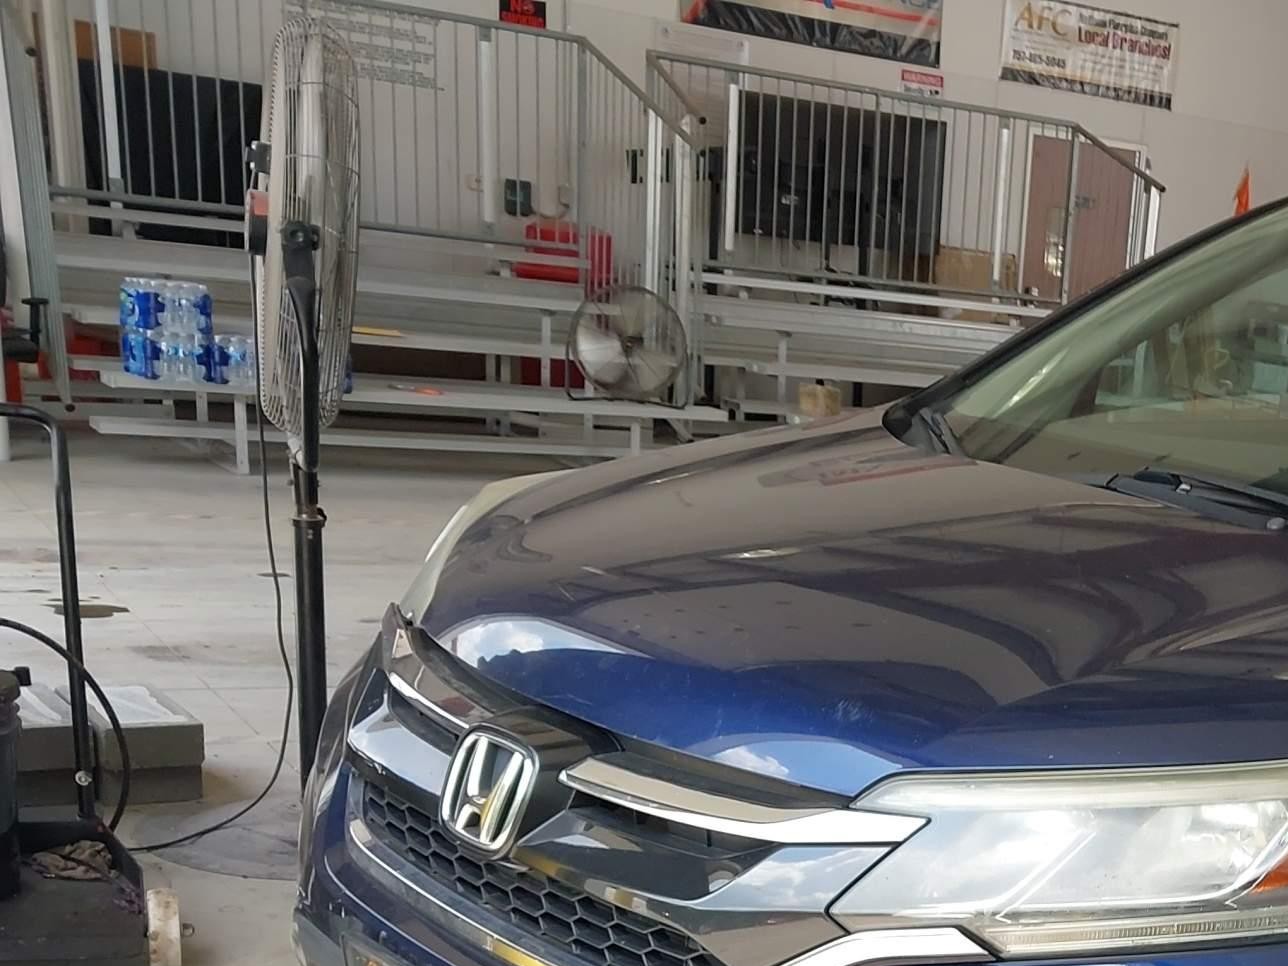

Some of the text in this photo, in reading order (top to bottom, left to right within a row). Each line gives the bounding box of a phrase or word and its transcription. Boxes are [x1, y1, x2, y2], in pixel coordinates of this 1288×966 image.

[1014, 0, 1072, 37] AFC
[1078, 26, 1110, 47] Local
[1112, 33, 1172, 61] Branches!
